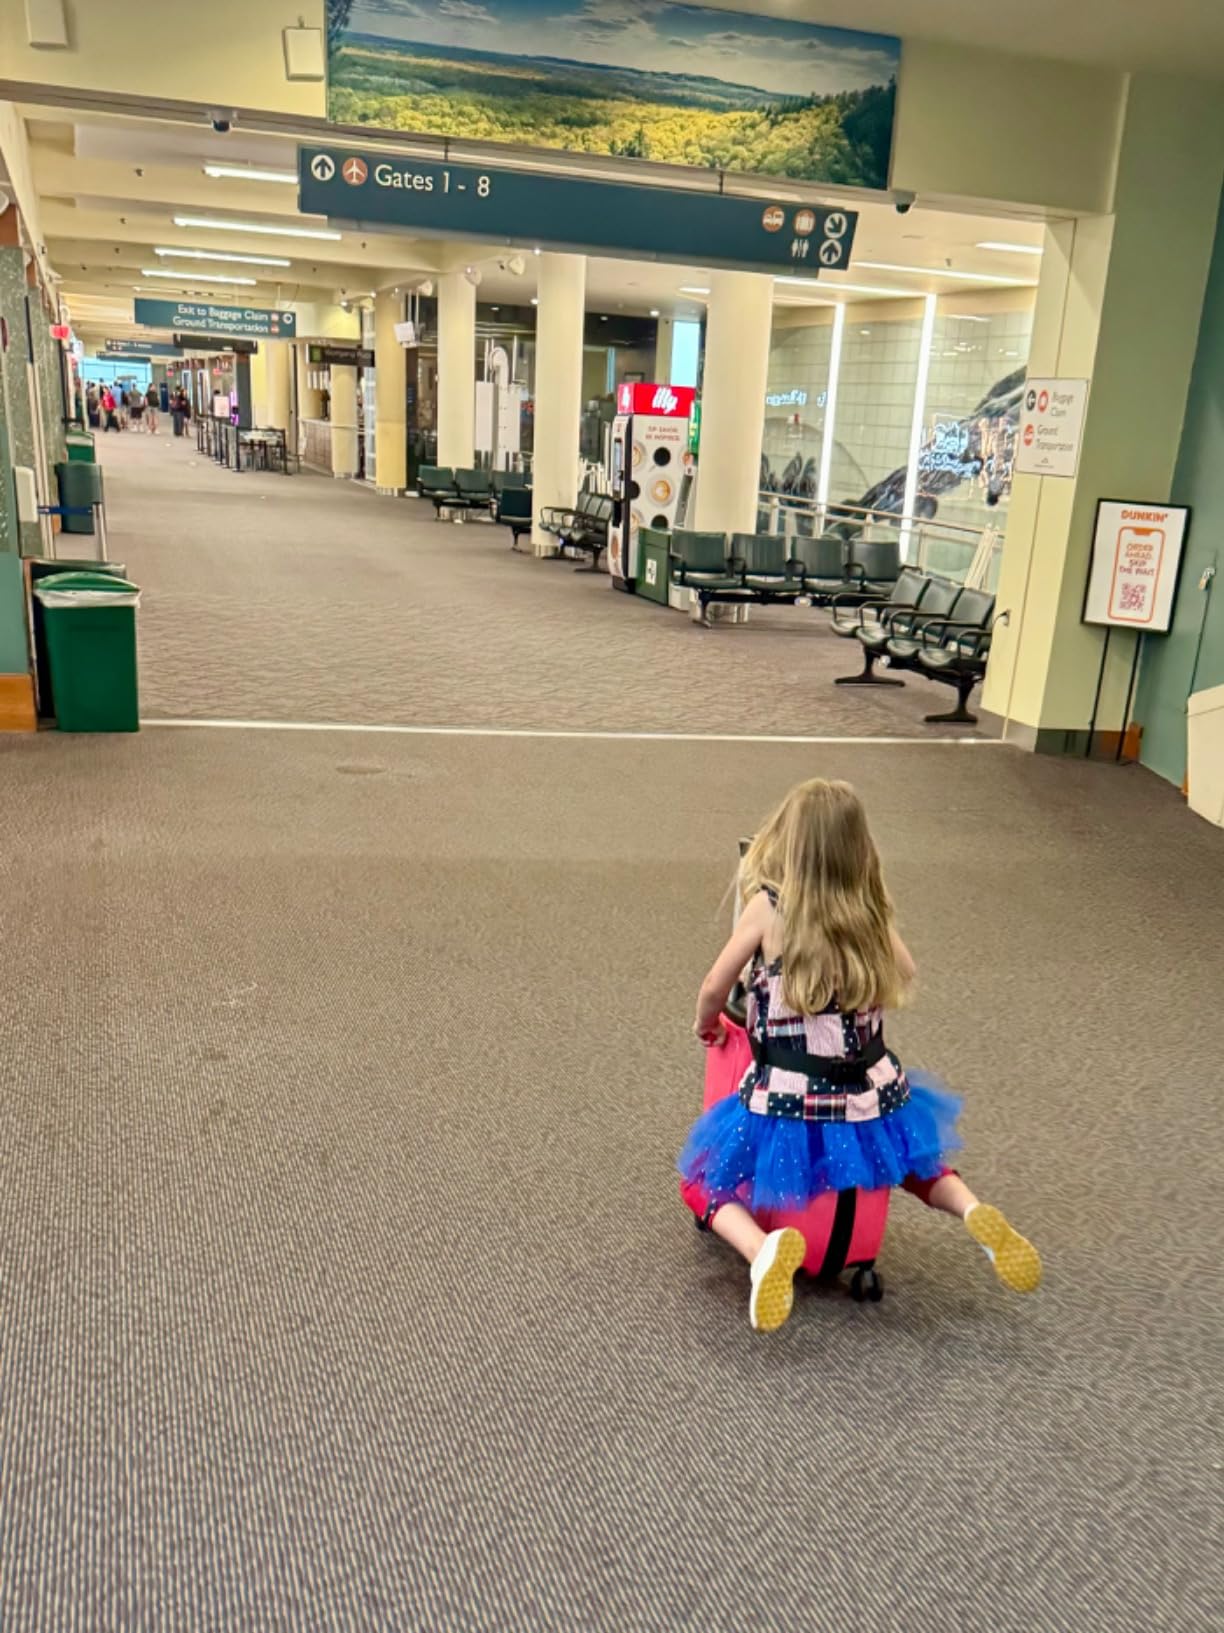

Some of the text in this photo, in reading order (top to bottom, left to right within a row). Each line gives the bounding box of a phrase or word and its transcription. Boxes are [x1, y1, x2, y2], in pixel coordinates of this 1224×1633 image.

[374, 164, 433, 192] Gates
[443, 171, 450, 193] 1
[477, 176, 490, 197] 8
[178, 304, 268, 321] Exit to Baggage Claim
[172, 316, 269, 333] Ground Transportation
[1121, 509, 1168, 523] DUNKIN'
[1126, 543, 1153, 552] ORDER
[1119, 566, 1133, 574] THE
[1129, 559, 1147, 568] SKIP
